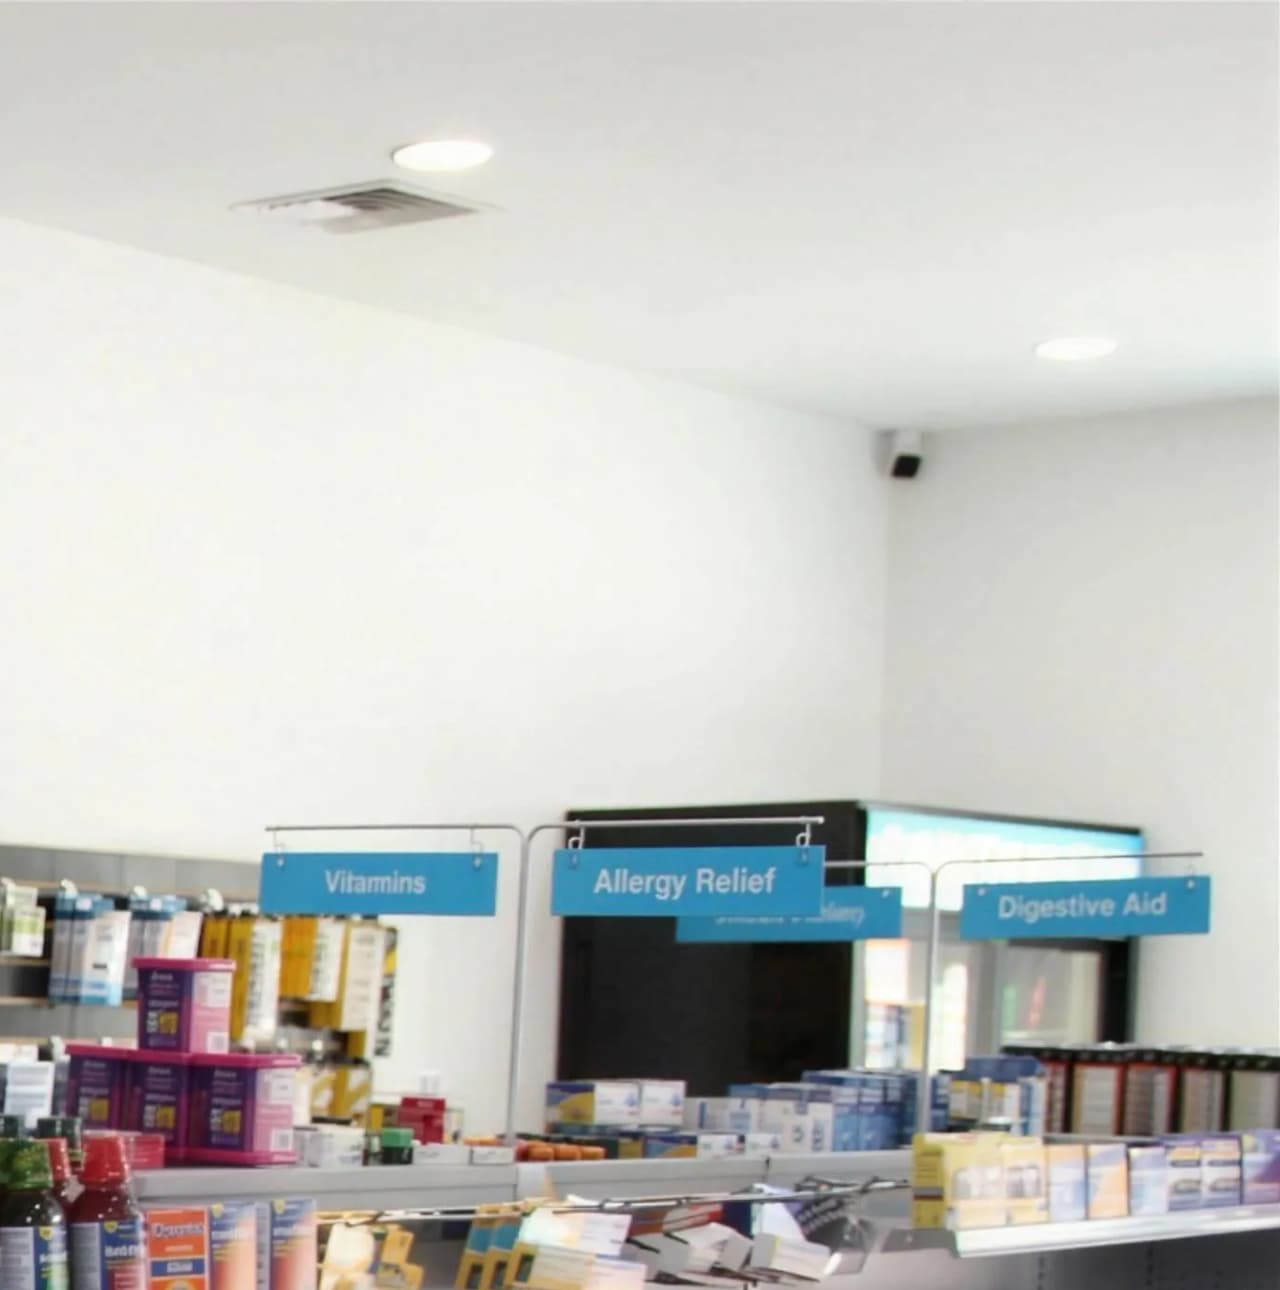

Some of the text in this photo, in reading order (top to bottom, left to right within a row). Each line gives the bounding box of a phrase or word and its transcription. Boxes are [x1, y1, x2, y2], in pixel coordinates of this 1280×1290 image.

[324, 868, 427, 895] Vitamins
[592, 866, 777, 900] Allergy Relief
[998, 890, 1168, 924] Digestive Aid
